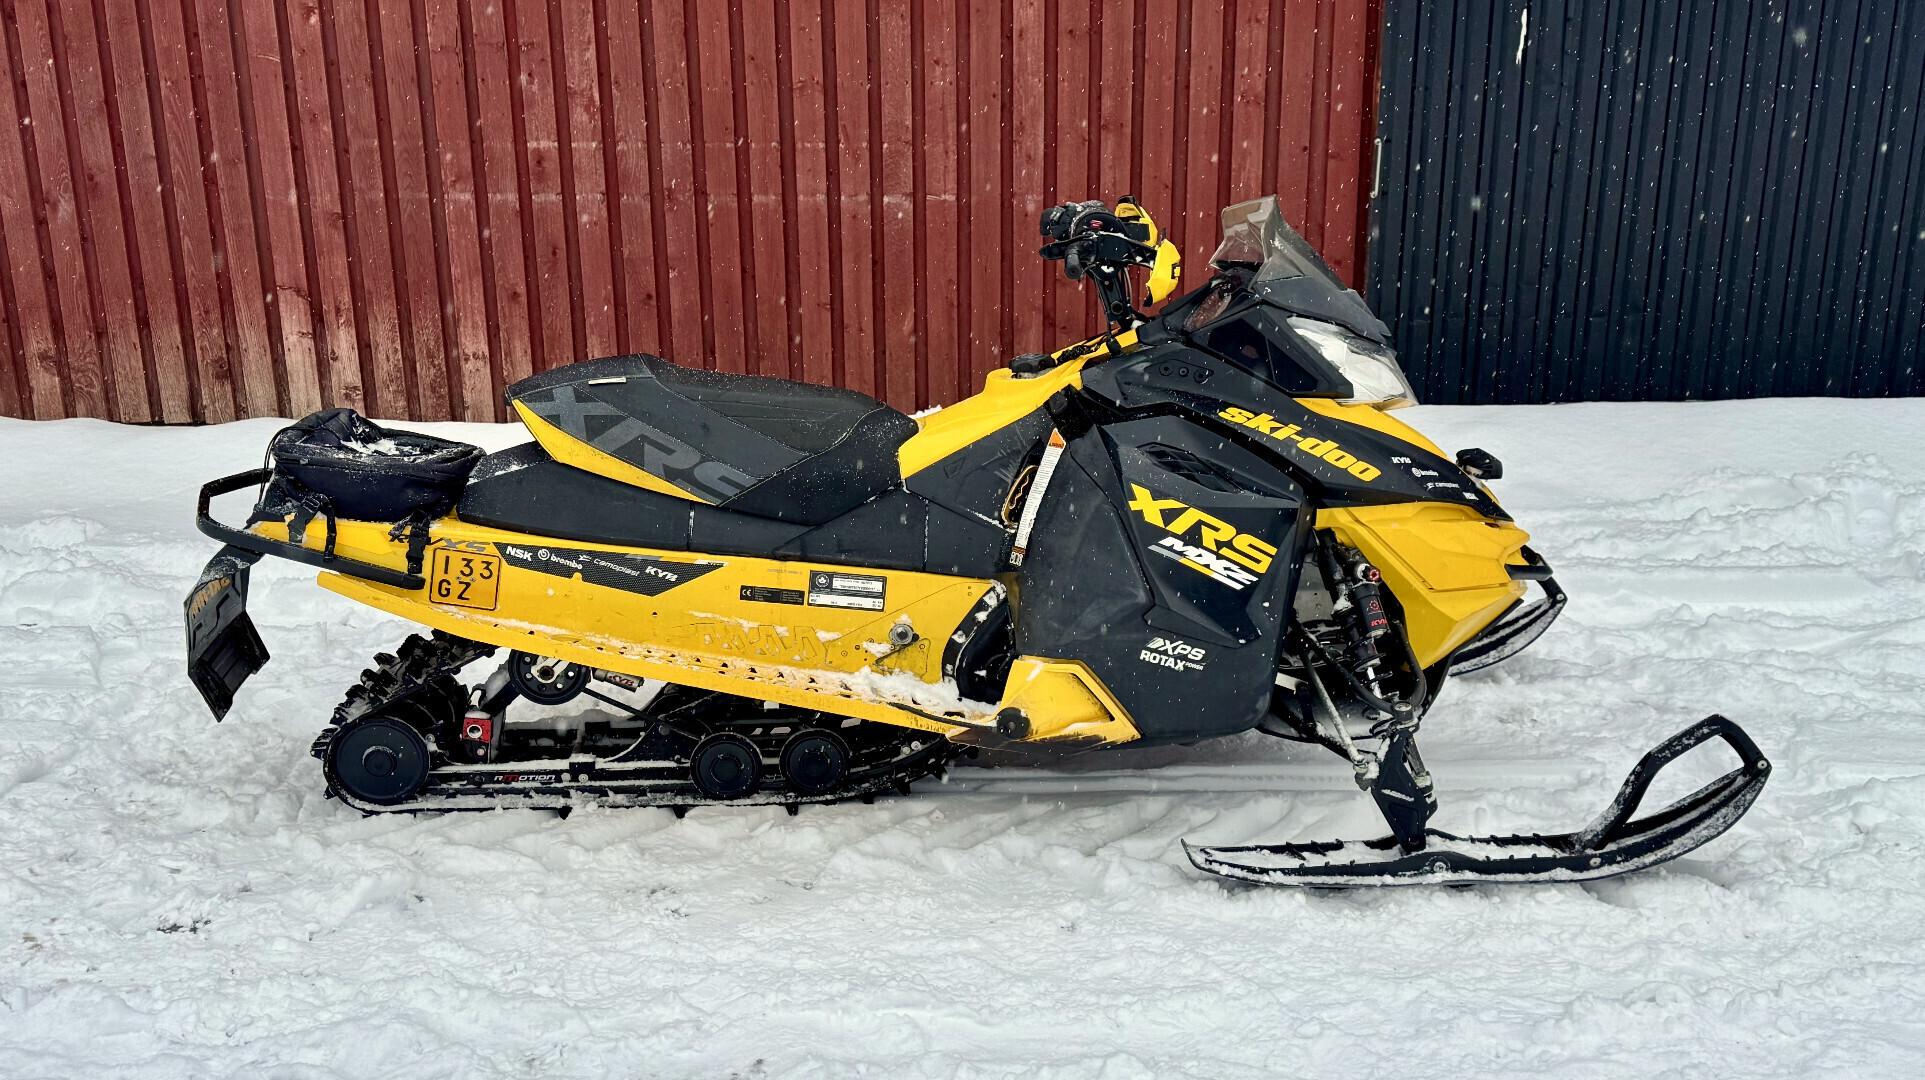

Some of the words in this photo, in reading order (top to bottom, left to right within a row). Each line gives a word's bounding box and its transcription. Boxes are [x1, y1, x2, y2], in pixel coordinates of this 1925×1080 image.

[526, 386, 758, 505] XRS
[1218, 407, 1382, 482] ski-doo
[1128, 482, 1278, 574] XRS
[506, 545, 533, 561] NSK
[550, 553, 583, 570] brembo
[645, 565, 678, 582] KYB
[437, 578, 472, 601] GZ
[1139, 649, 1186, 672] ROTAX
[1157, 639, 1206, 661] XPS
